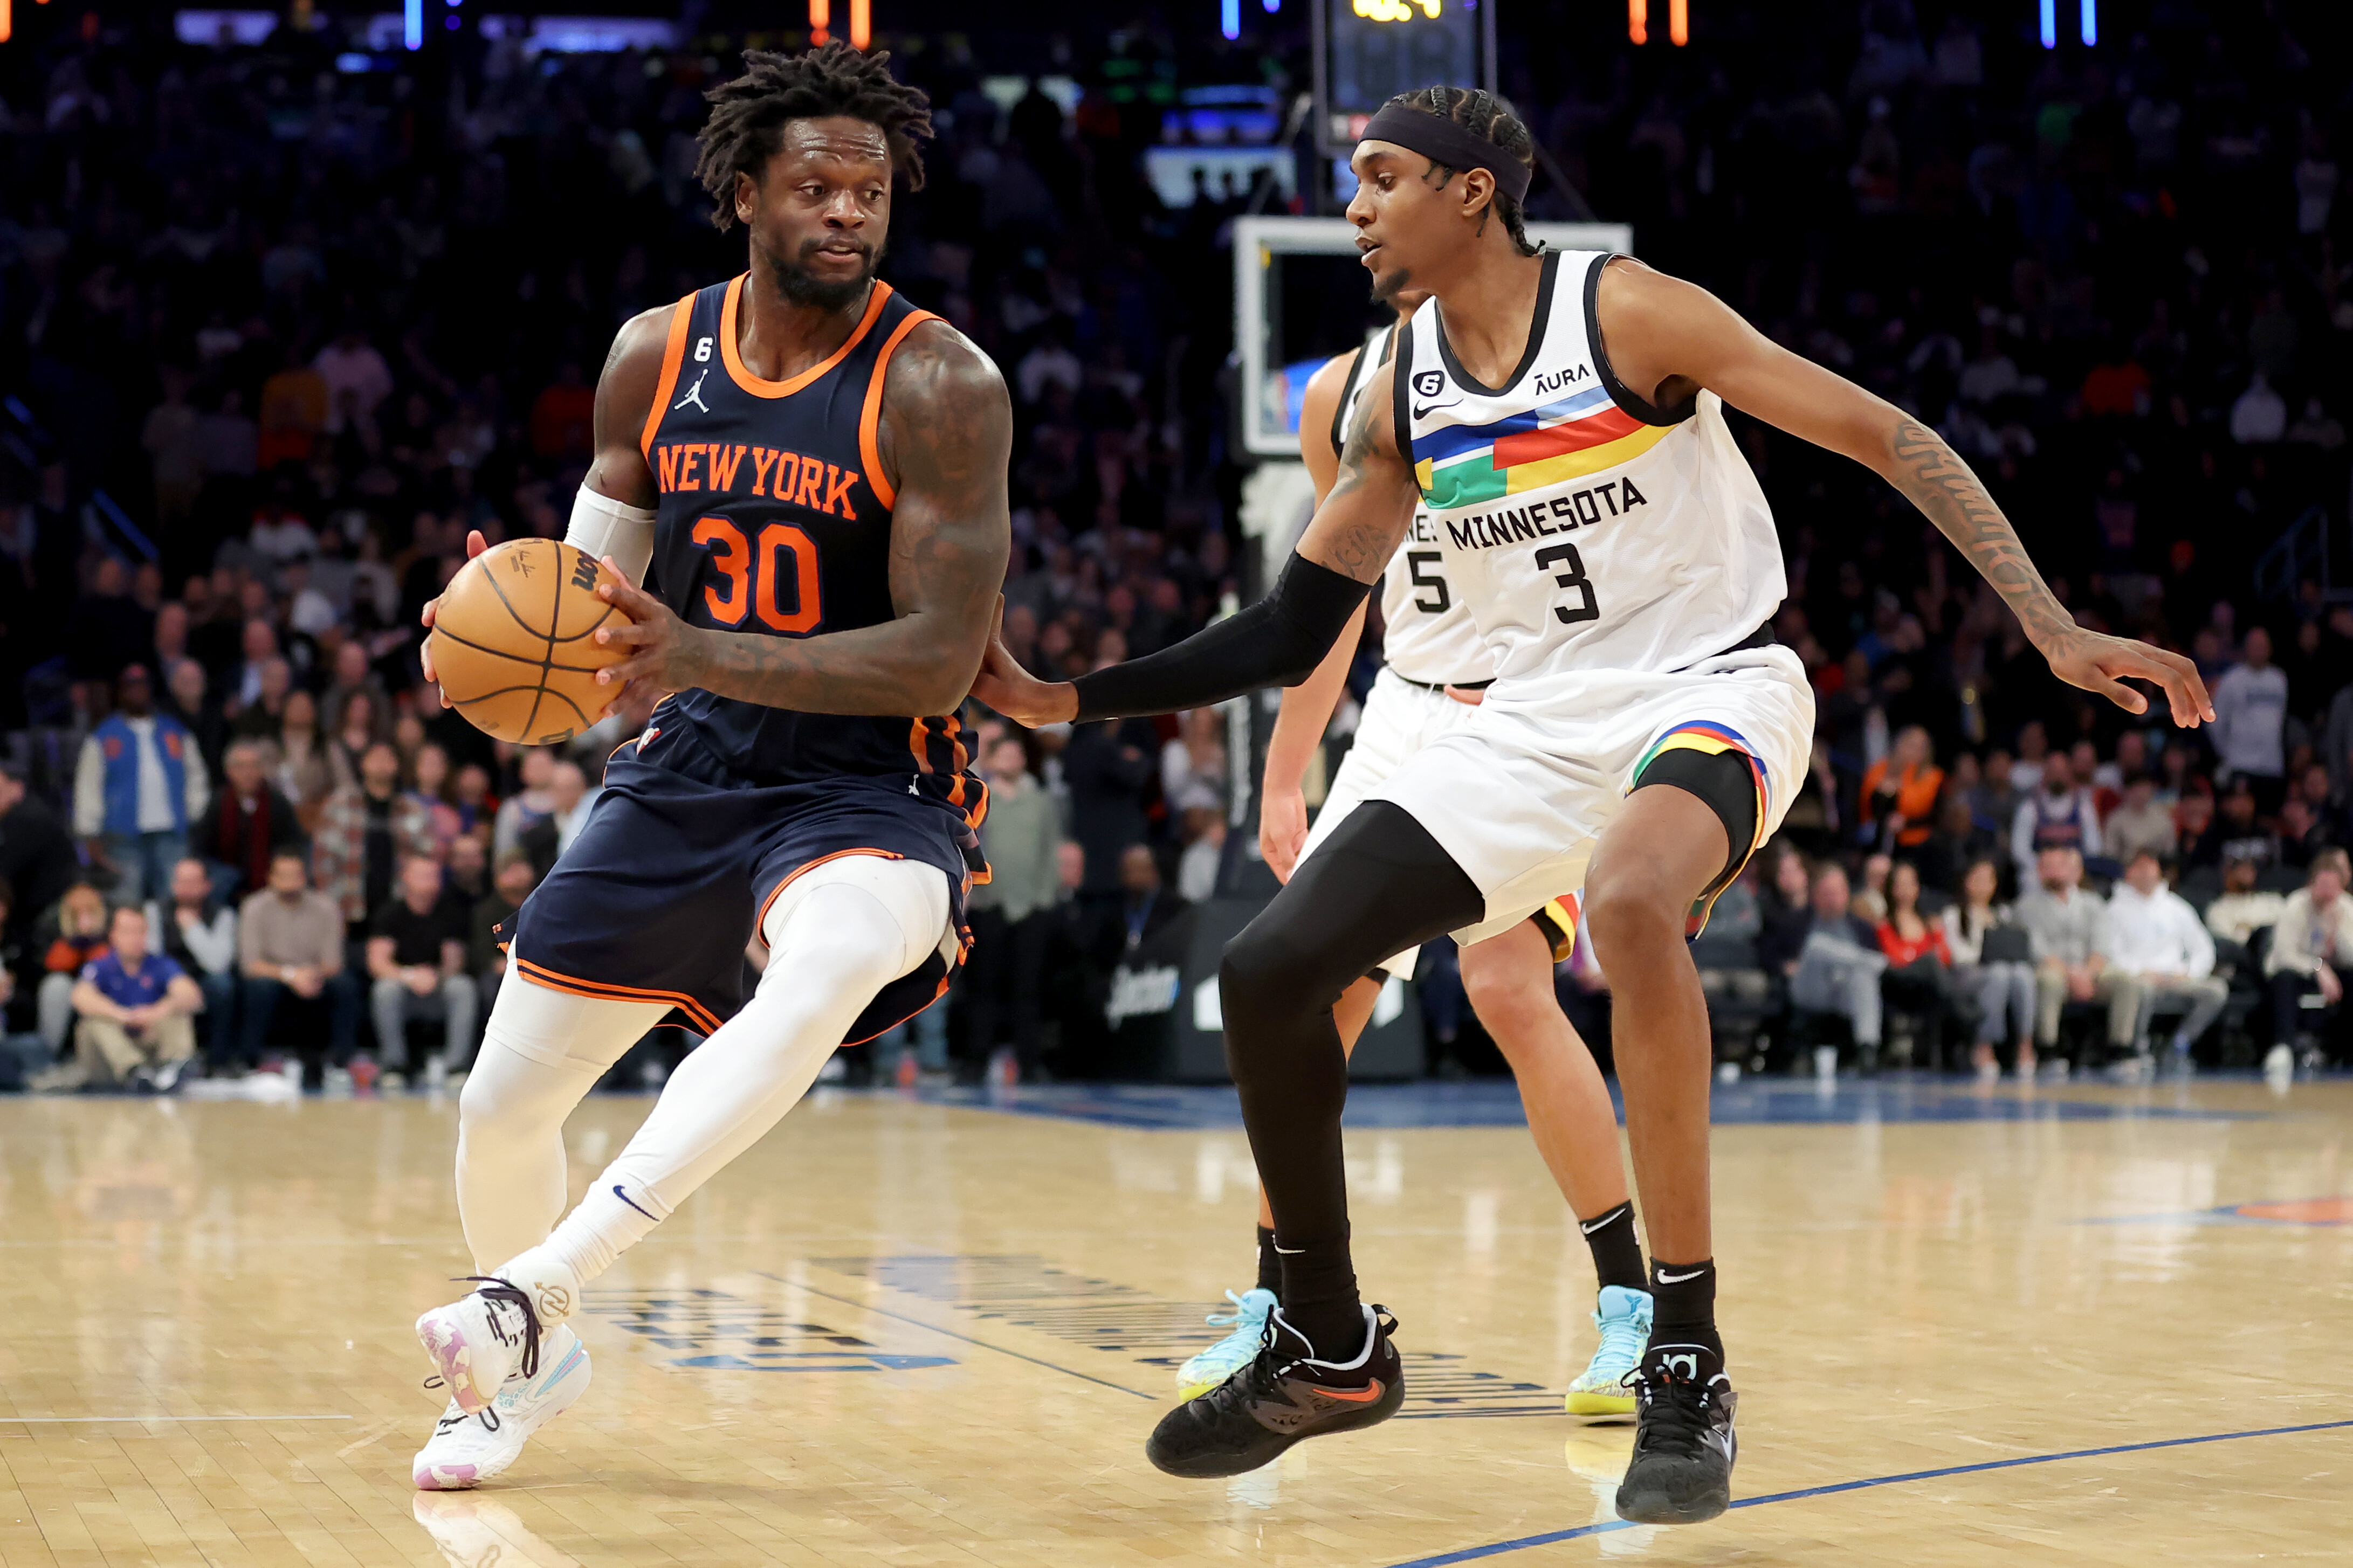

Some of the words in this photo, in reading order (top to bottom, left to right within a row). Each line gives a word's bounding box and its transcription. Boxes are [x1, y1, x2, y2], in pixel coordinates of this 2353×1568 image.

[694, 337, 713, 363] 6
[1418, 373, 1442, 396] 6
[657, 443, 747, 494] NEW
[751, 445, 860, 521] YORK
[1445, 476, 1648, 551] MINNESOTA
[691, 515, 824, 637] 30
[1407, 551, 1451, 613] 5
[1534, 542, 1600, 624] 3
